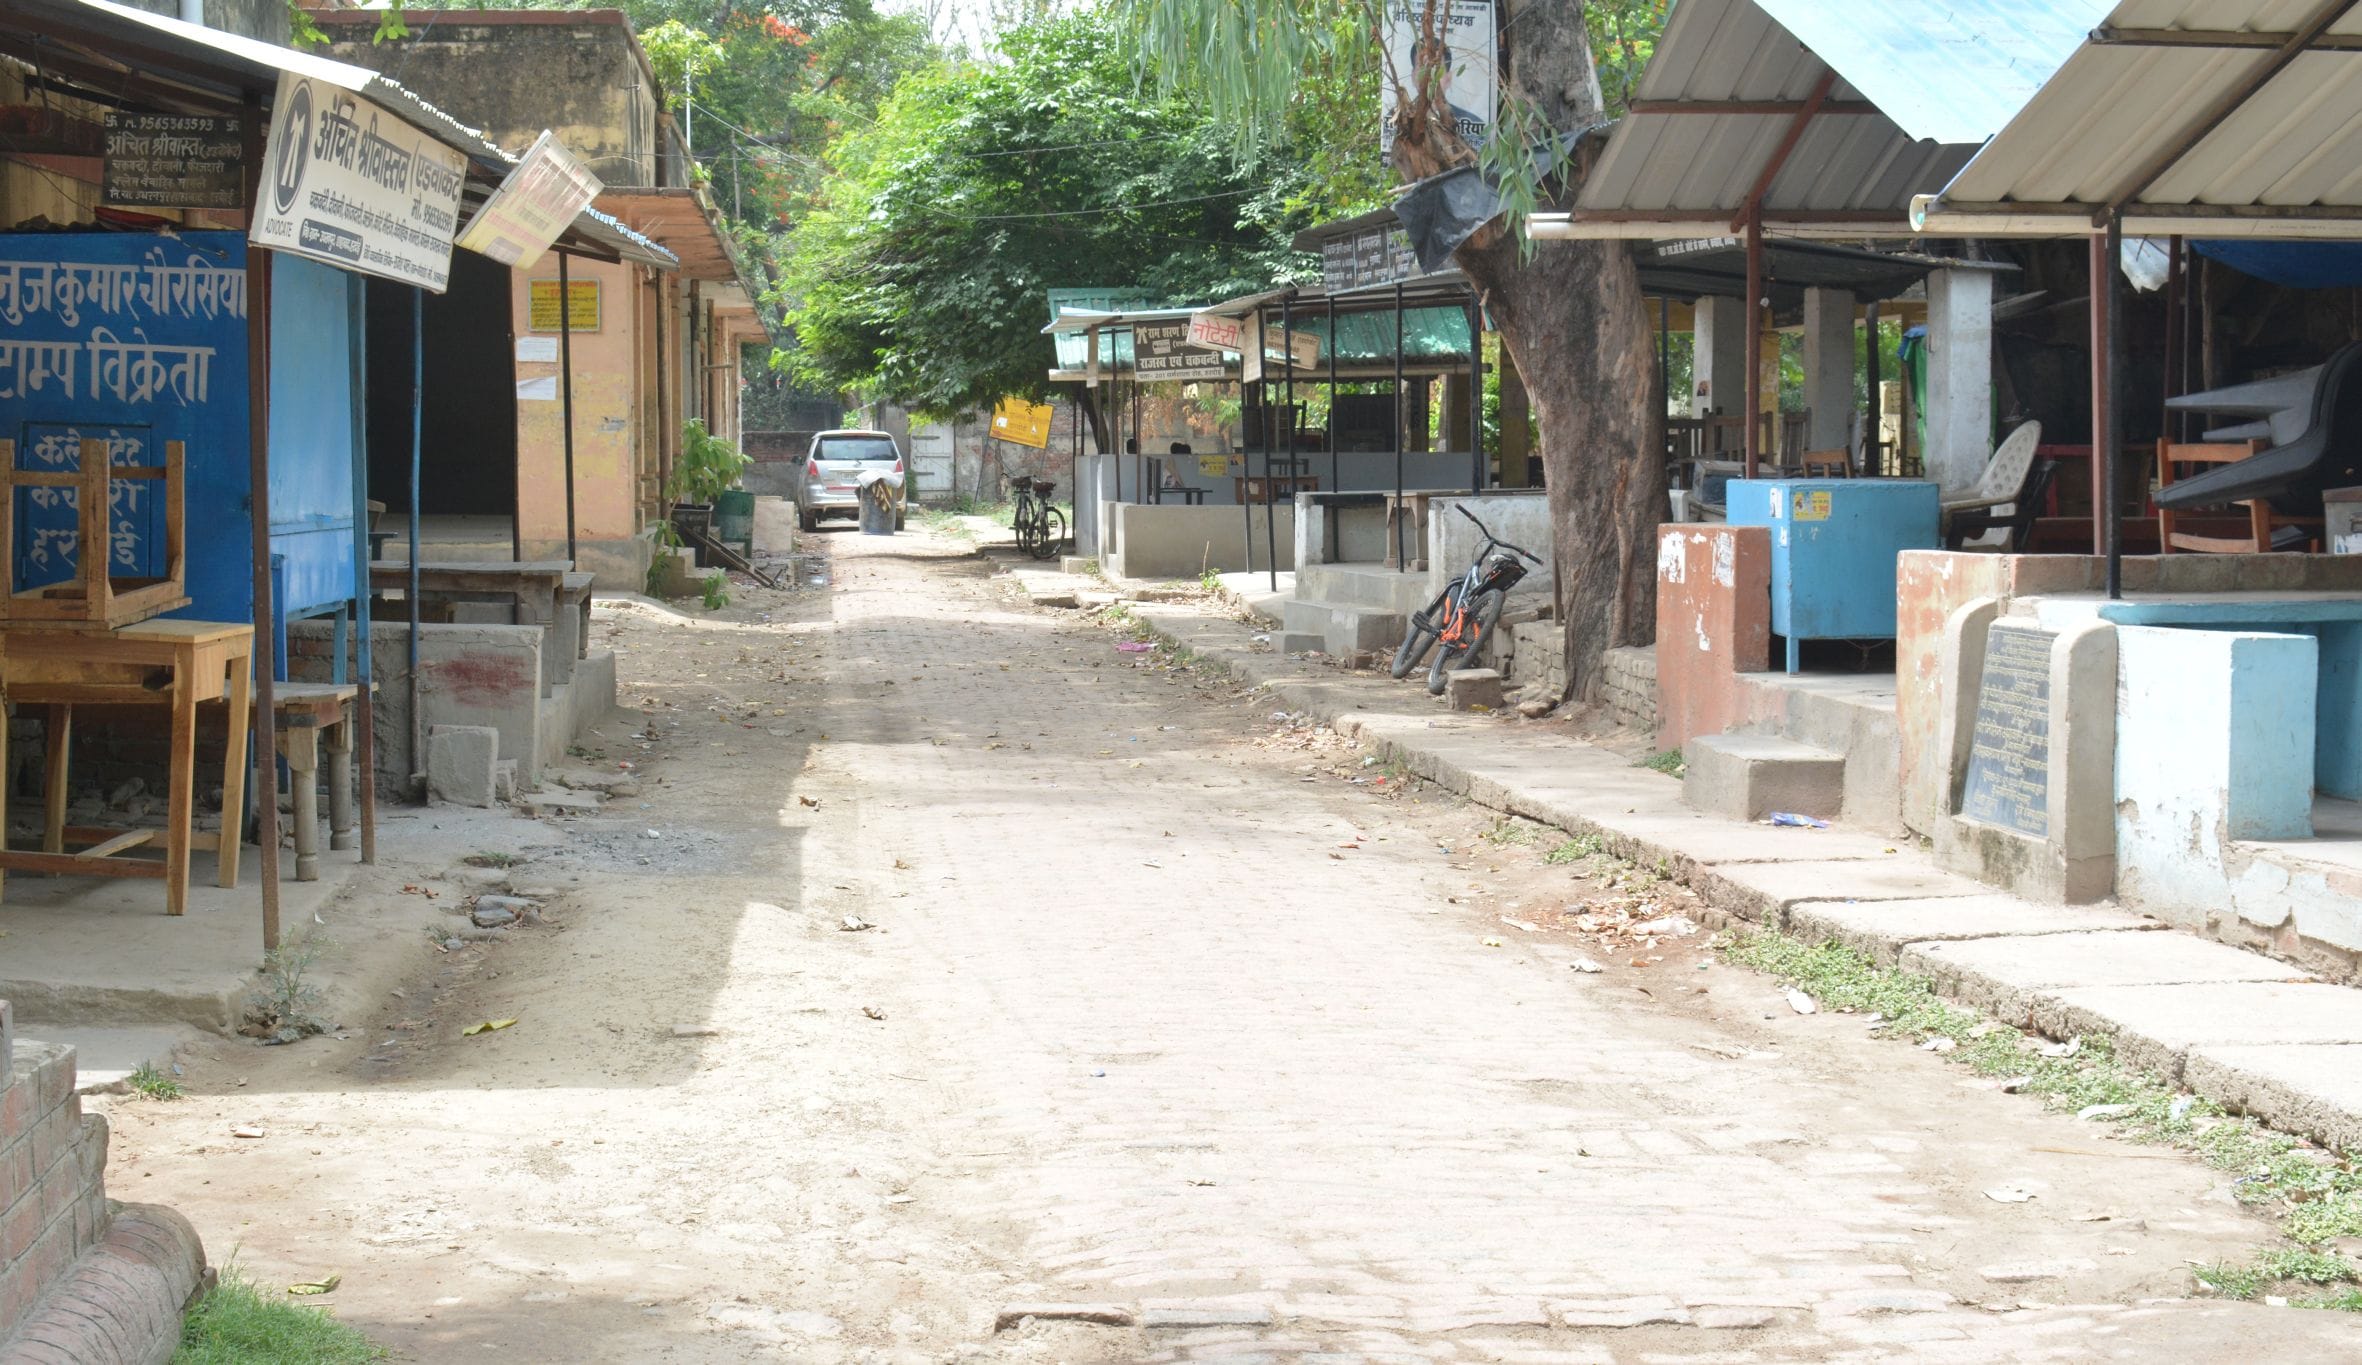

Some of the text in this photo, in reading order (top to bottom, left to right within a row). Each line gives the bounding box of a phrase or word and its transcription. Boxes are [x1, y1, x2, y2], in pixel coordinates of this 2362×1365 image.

[106, 130, 150, 156] अंचित
[314, 93, 360, 171] अंचित
[358, 111, 411, 194] श्रीवास्तव
[265, 218, 293, 238] ADVOCATE
[55, 262, 139, 328] कुमार
[138, 246, 247, 321] चौरसिया
[1147, 327, 1160, 339] राम
[1193, 320, 1238, 347] नोटेरी
[86, 326, 217, 407] विक्रेता
[1140, 350, 1220, 370] राजस्व एवं चकबन्दी
